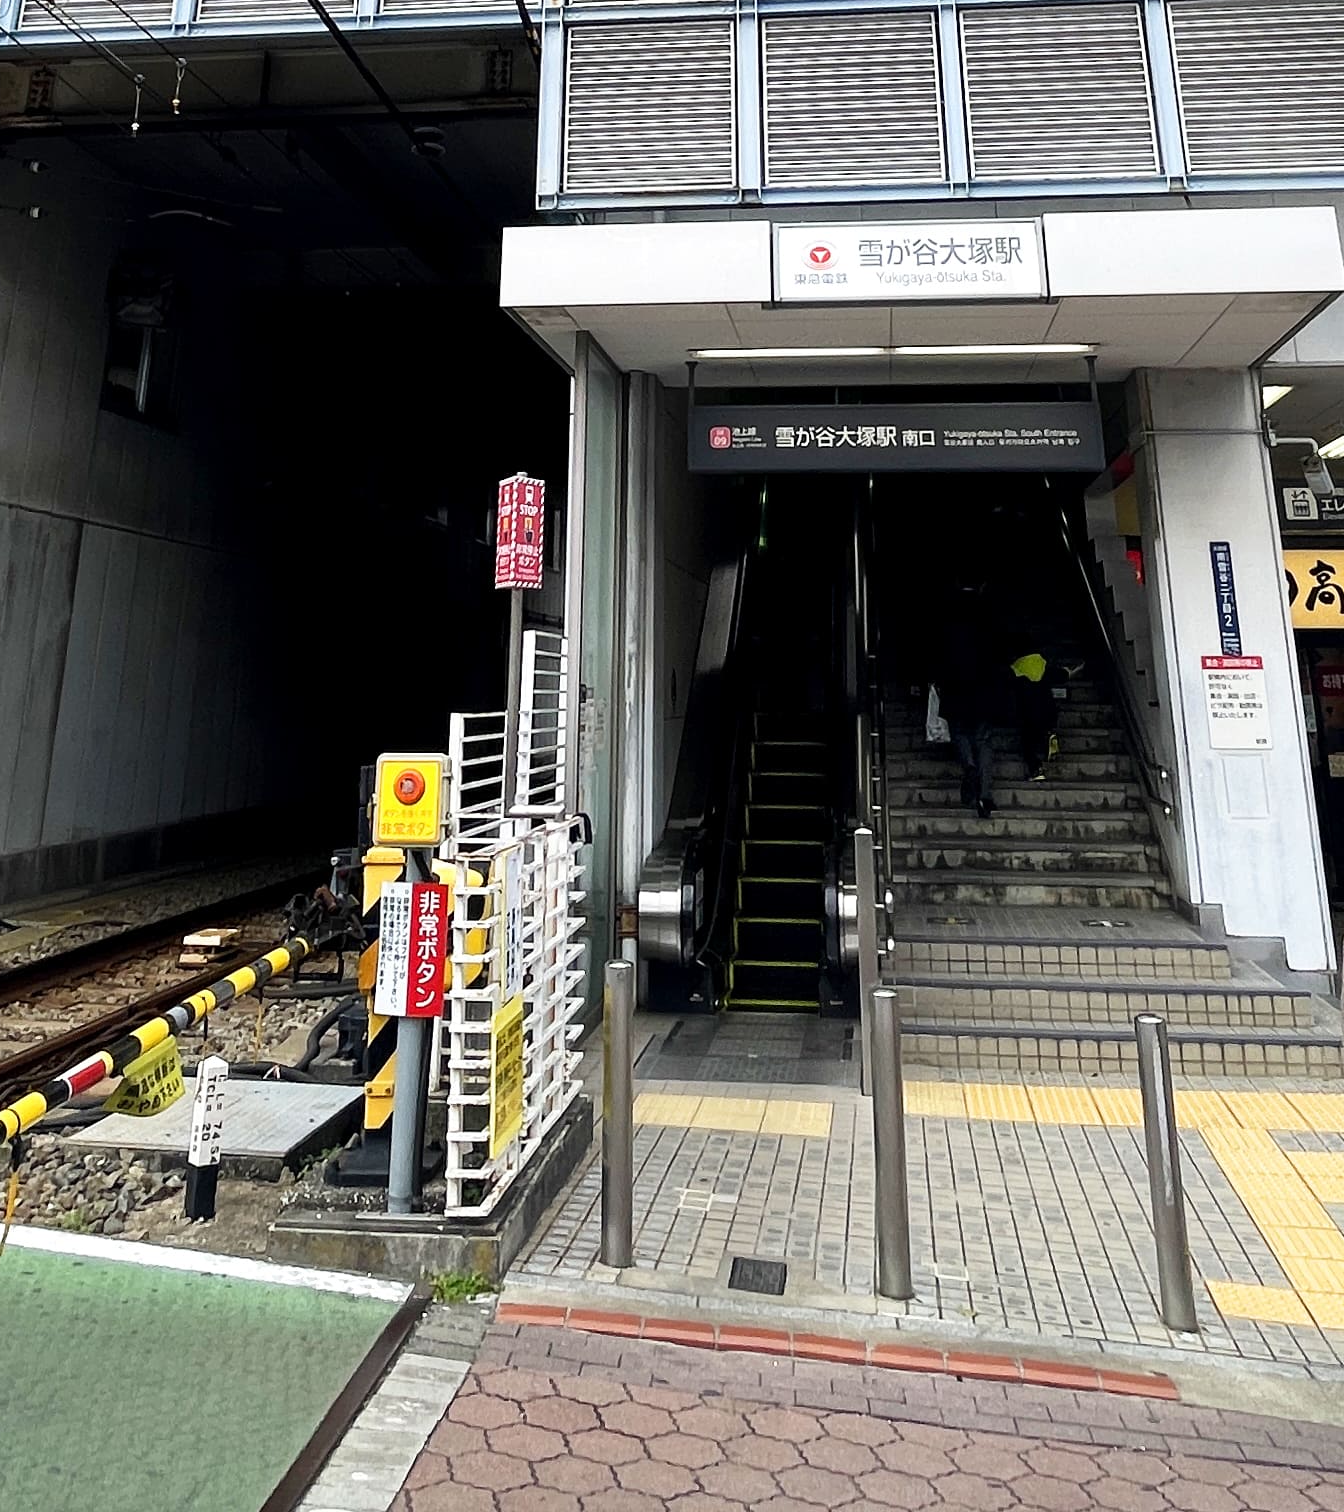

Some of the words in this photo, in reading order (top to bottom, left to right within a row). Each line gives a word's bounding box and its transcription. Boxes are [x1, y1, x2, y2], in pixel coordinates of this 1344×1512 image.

[858, 237, 1023, 267] 雪が谷大塚駅
[794, 273, 848, 285] 東急電鉄
[982, 269, 1007, 282] Sta.
[775, 426, 898, 448] 雪が谷大塚駅
[902, 430, 936, 447] 南口
[1021, 429, 1043, 437] South
[1044, 429, 1077, 437] Entrance
[519, 504, 539, 516] STOP
[381, 821, 434, 836] 非常ボタン
[415, 891, 440, 1008] 非常ボタン
